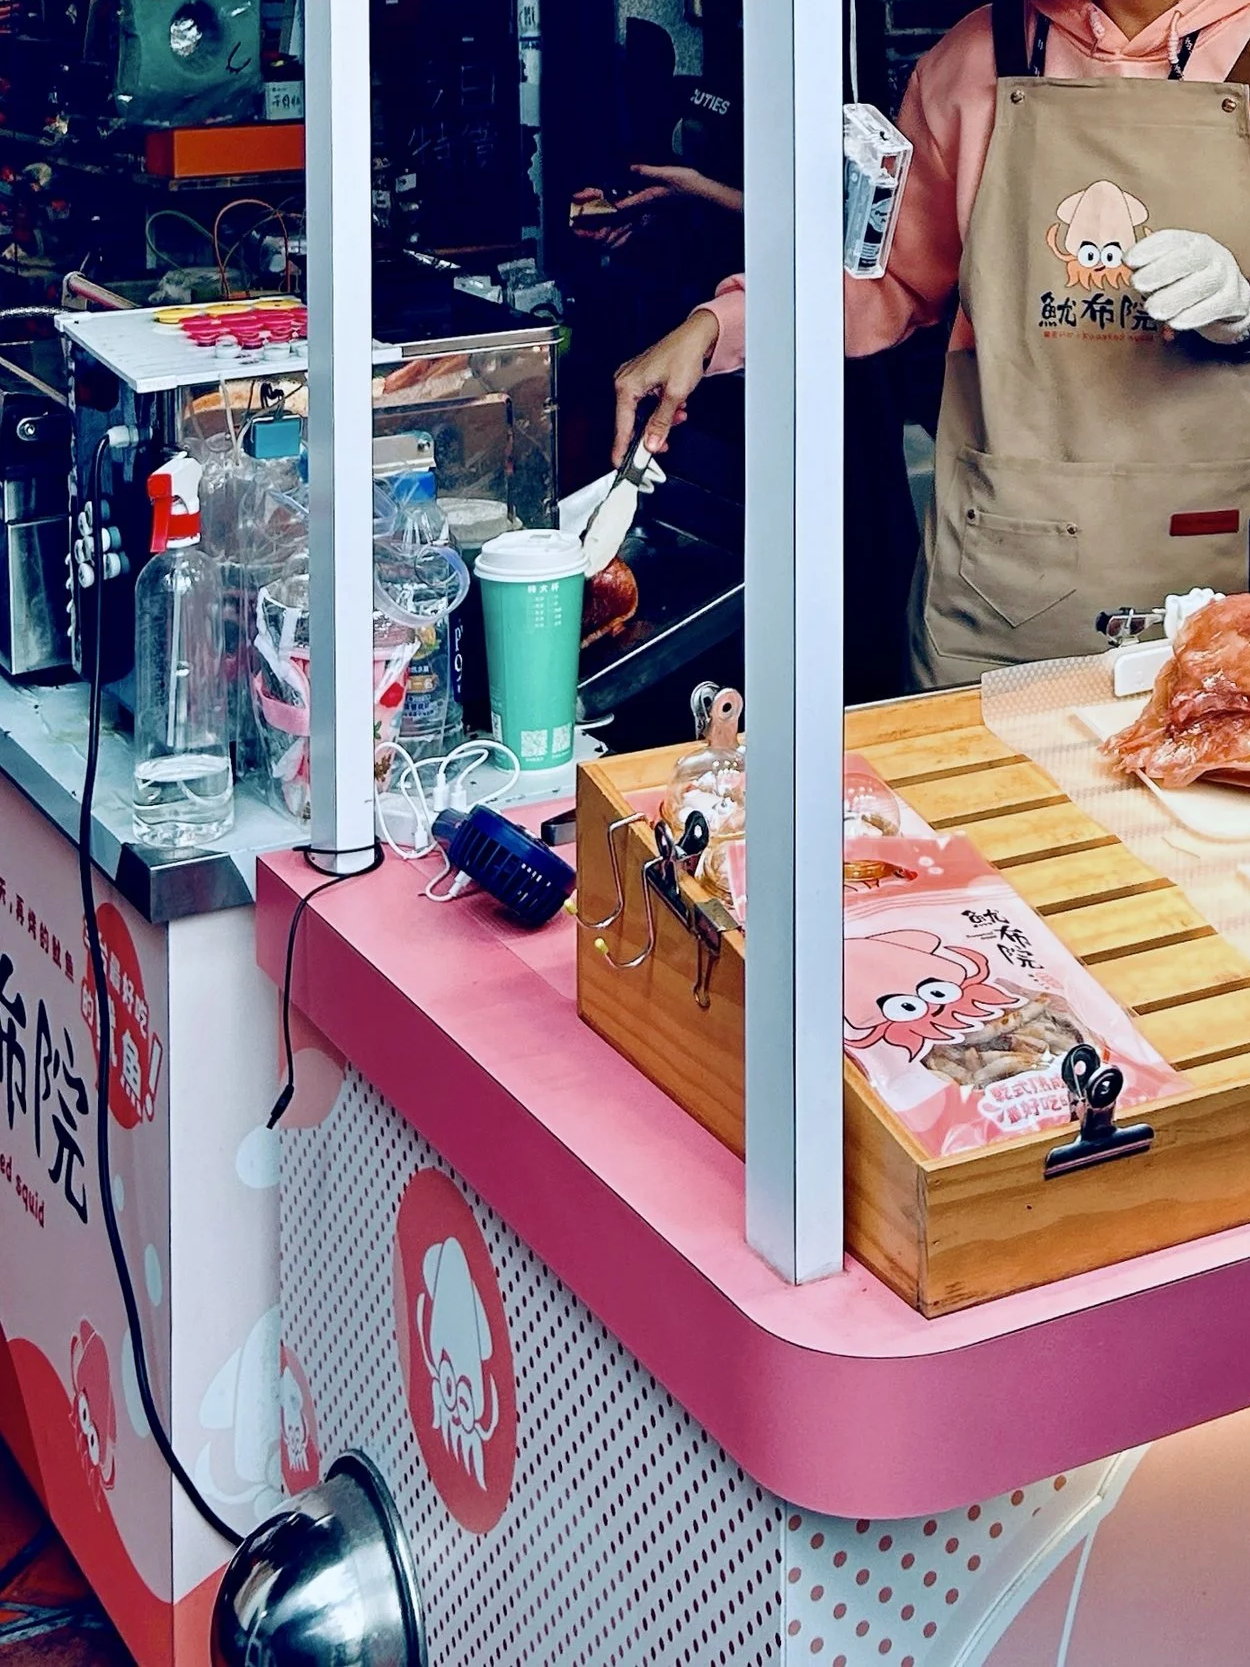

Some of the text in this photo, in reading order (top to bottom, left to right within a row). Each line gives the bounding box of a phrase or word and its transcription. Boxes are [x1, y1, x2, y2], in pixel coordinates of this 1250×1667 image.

[1038, 290, 1159, 332] 魷布院
[16, 1174, 45, 1229] squid
